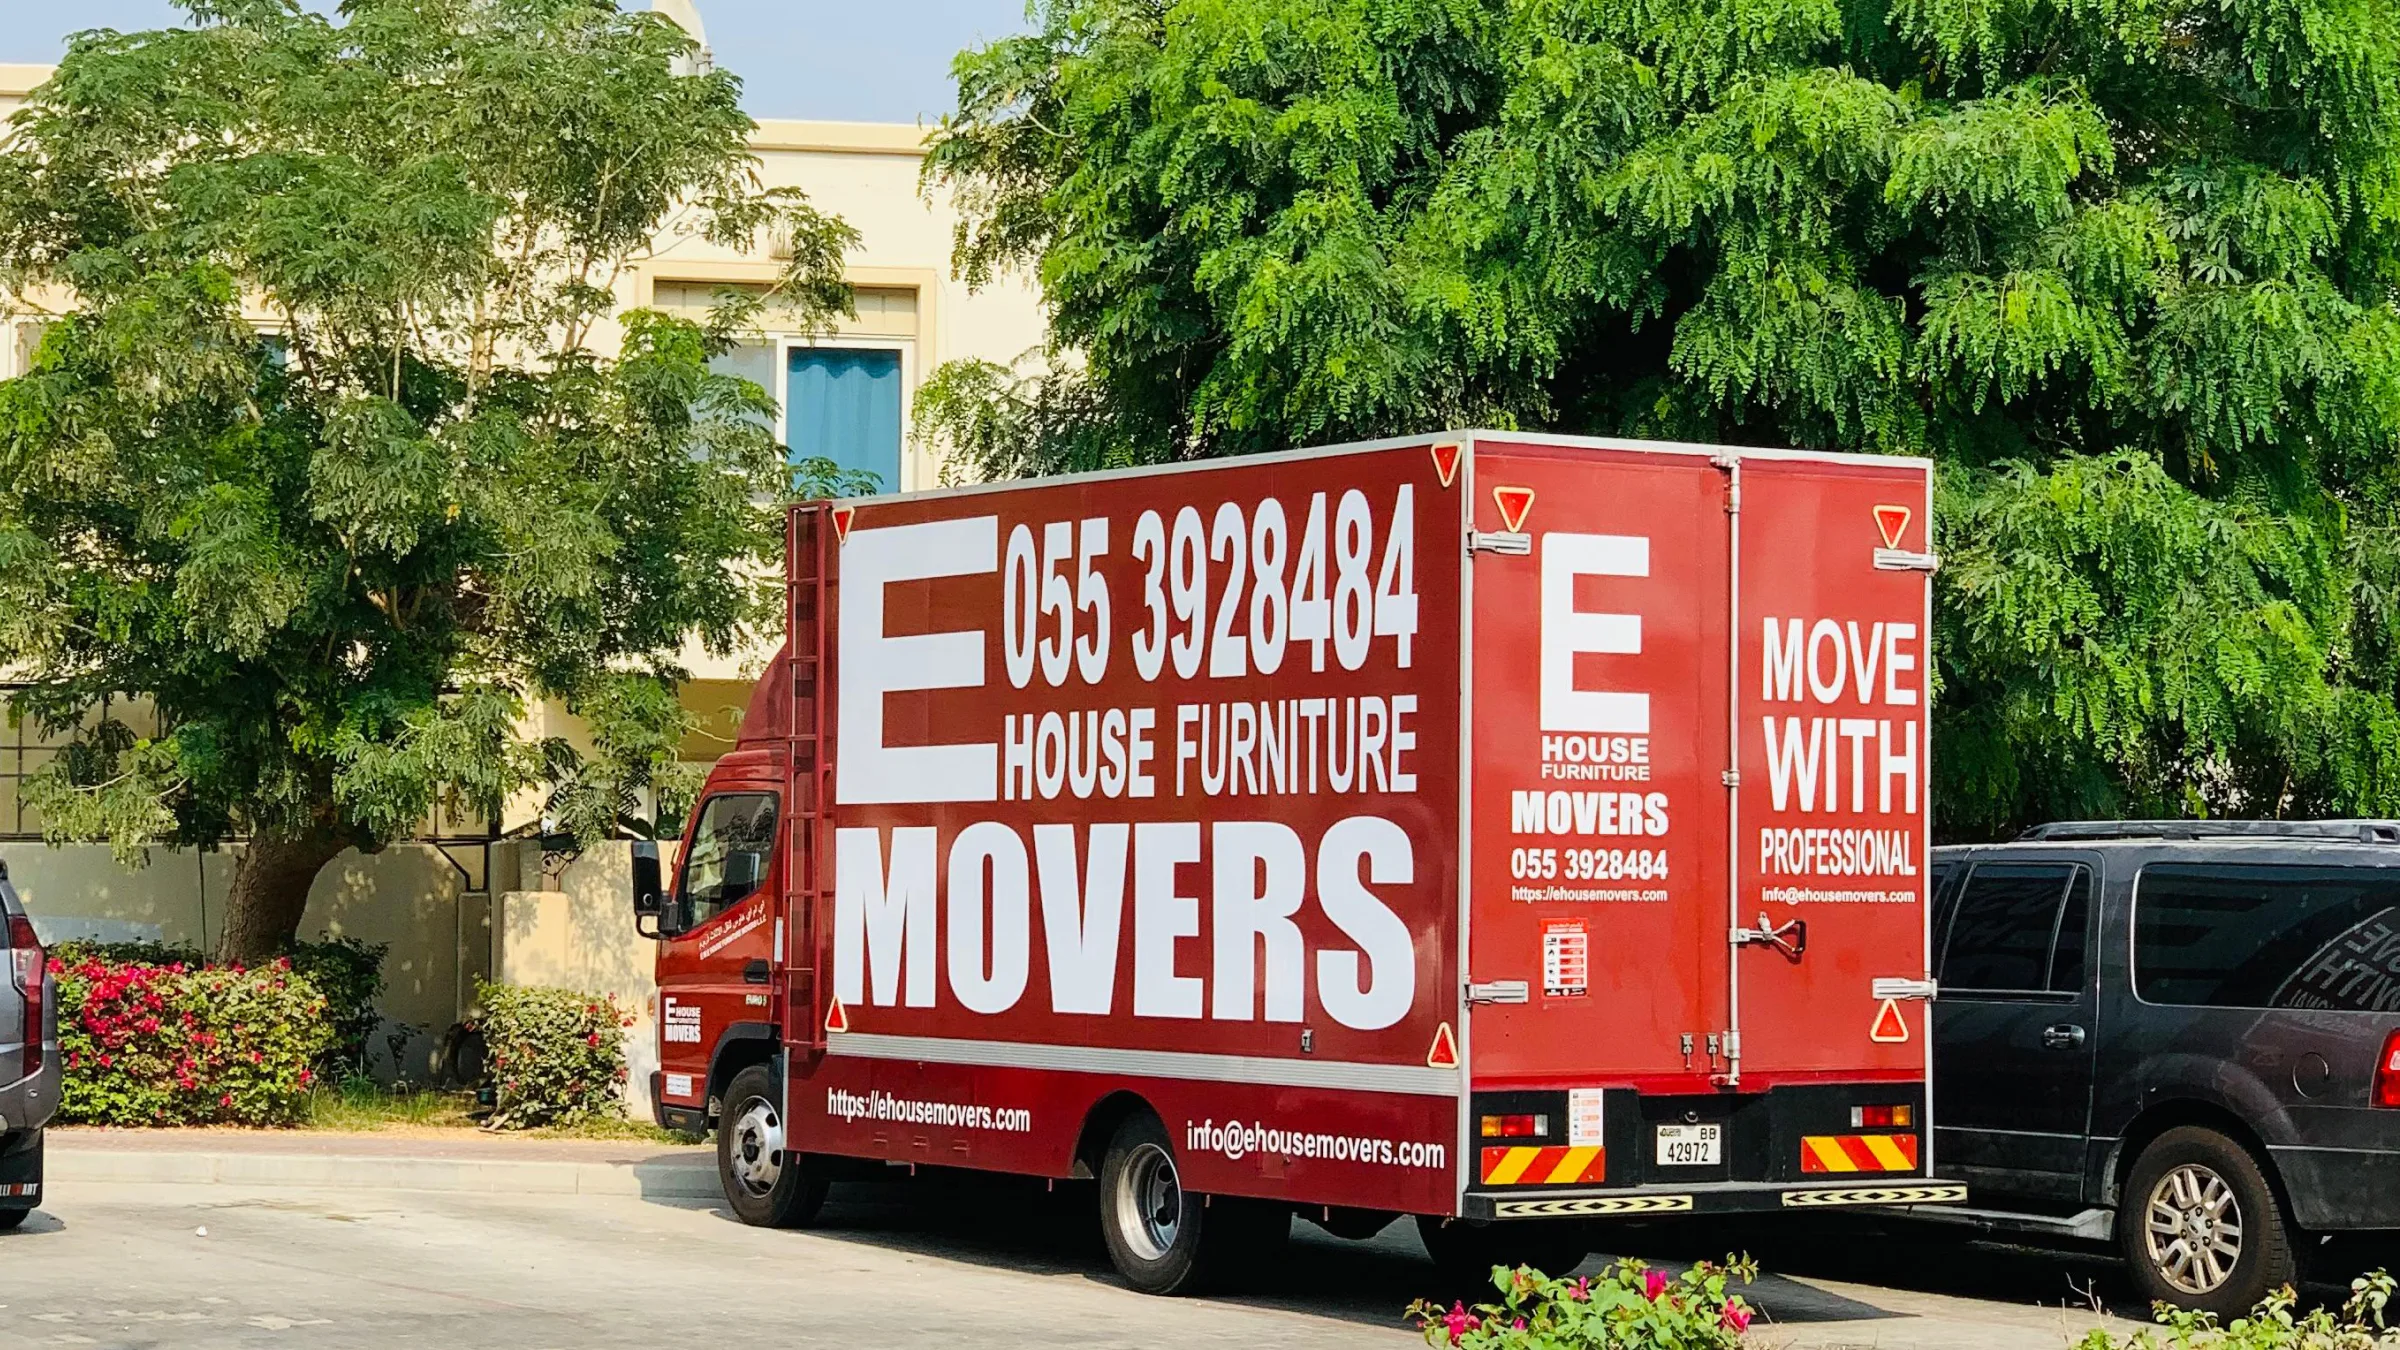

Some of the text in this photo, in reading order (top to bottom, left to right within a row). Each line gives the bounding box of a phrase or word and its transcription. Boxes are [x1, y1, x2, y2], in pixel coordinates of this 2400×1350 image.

[1004, 483, 1419, 689] 055 3928484
[1540, 532, 1650, 734] E
[837, 515, 997, 804] E
[1763, 617, 1917, 706] MOVE
[1005, 694, 1417, 800] HOUSE FURNITURE
[1541, 735, 1650, 764] HOUSE
[1763, 716, 1917, 814] WITH
[1541, 763, 1650, 781] FURNITURE
[1511, 790, 1669, 836] MOVERS
[1511, 848, 1668, 880] 055 3928484
[1760, 828, 1917, 876] PROFESSIONAL
[1511, 885, 1668, 904] https://ehousemovers.com
[1762, 887, 1916, 905] info@ehousemovers.com
[834, 816, 1415, 1030] MOVERS
[664, 997, 677, 1024] E
[664, 1025, 701, 1043] MOVERS
[827, 1087, 1030, 1132] https://ehousemovers.com
[1187, 1119, 1445, 1169] info@ehousemovers.com
[1668, 1142, 1709, 1162] 42972
